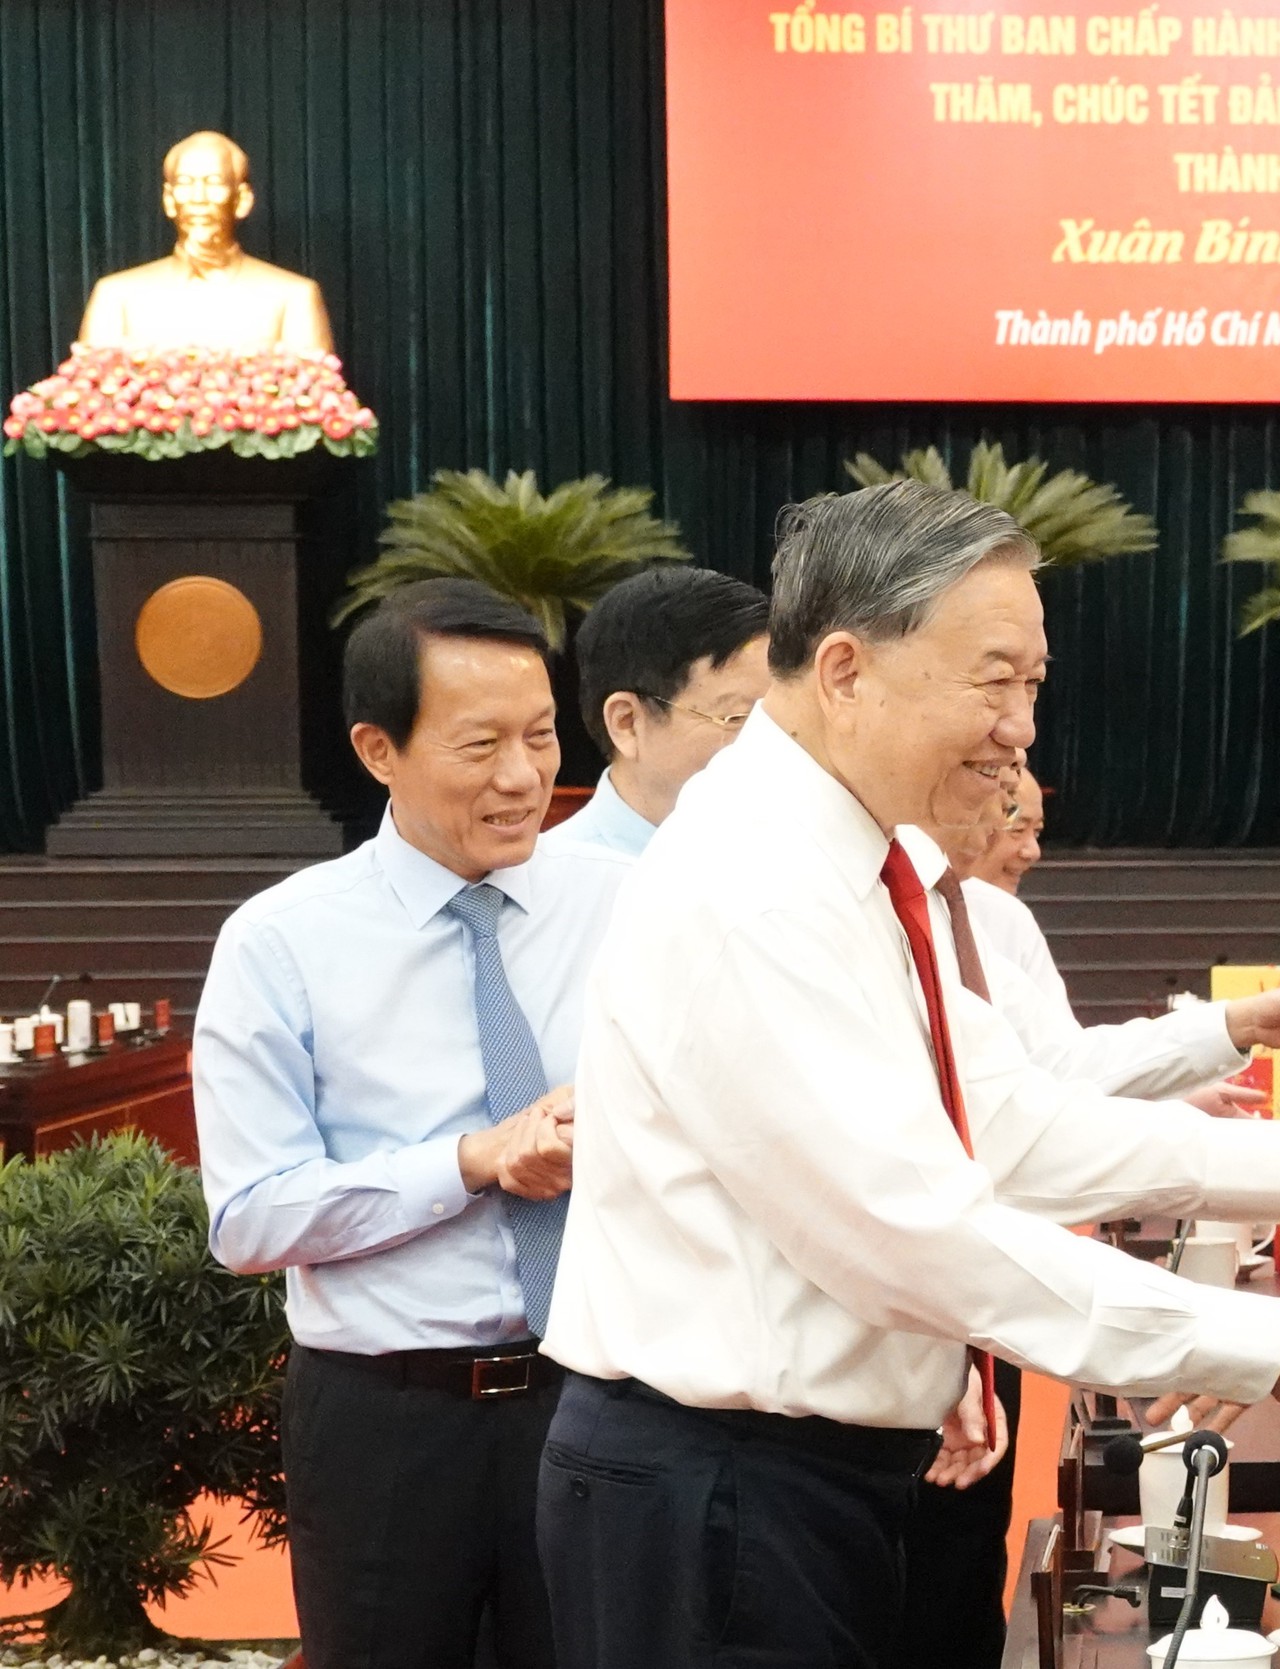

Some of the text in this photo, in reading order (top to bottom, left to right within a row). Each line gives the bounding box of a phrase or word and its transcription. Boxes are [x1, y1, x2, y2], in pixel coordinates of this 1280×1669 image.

[770, 0, 865, 52] TỔNG
[877, 8, 911, 52] BÍ
[923, 13, 994, 53] THƯ
[1003, 16, 1075, 54] BAN
[1087, 5, 1181, 55] CHẤP
[930, 77, 1042, 127] THĂM,
[1054, 77, 1148, 123] CHÚC
[1159, 74, 1219, 123] TẾT
[1052, 219, 1184, 263] Xuân
[996, 309, 1091, 345] Thành
[1094, 307, 1162, 354] phố
[1162, 307, 1207, 346] Hồ
[1211, 310, 1263, 346] Chí
